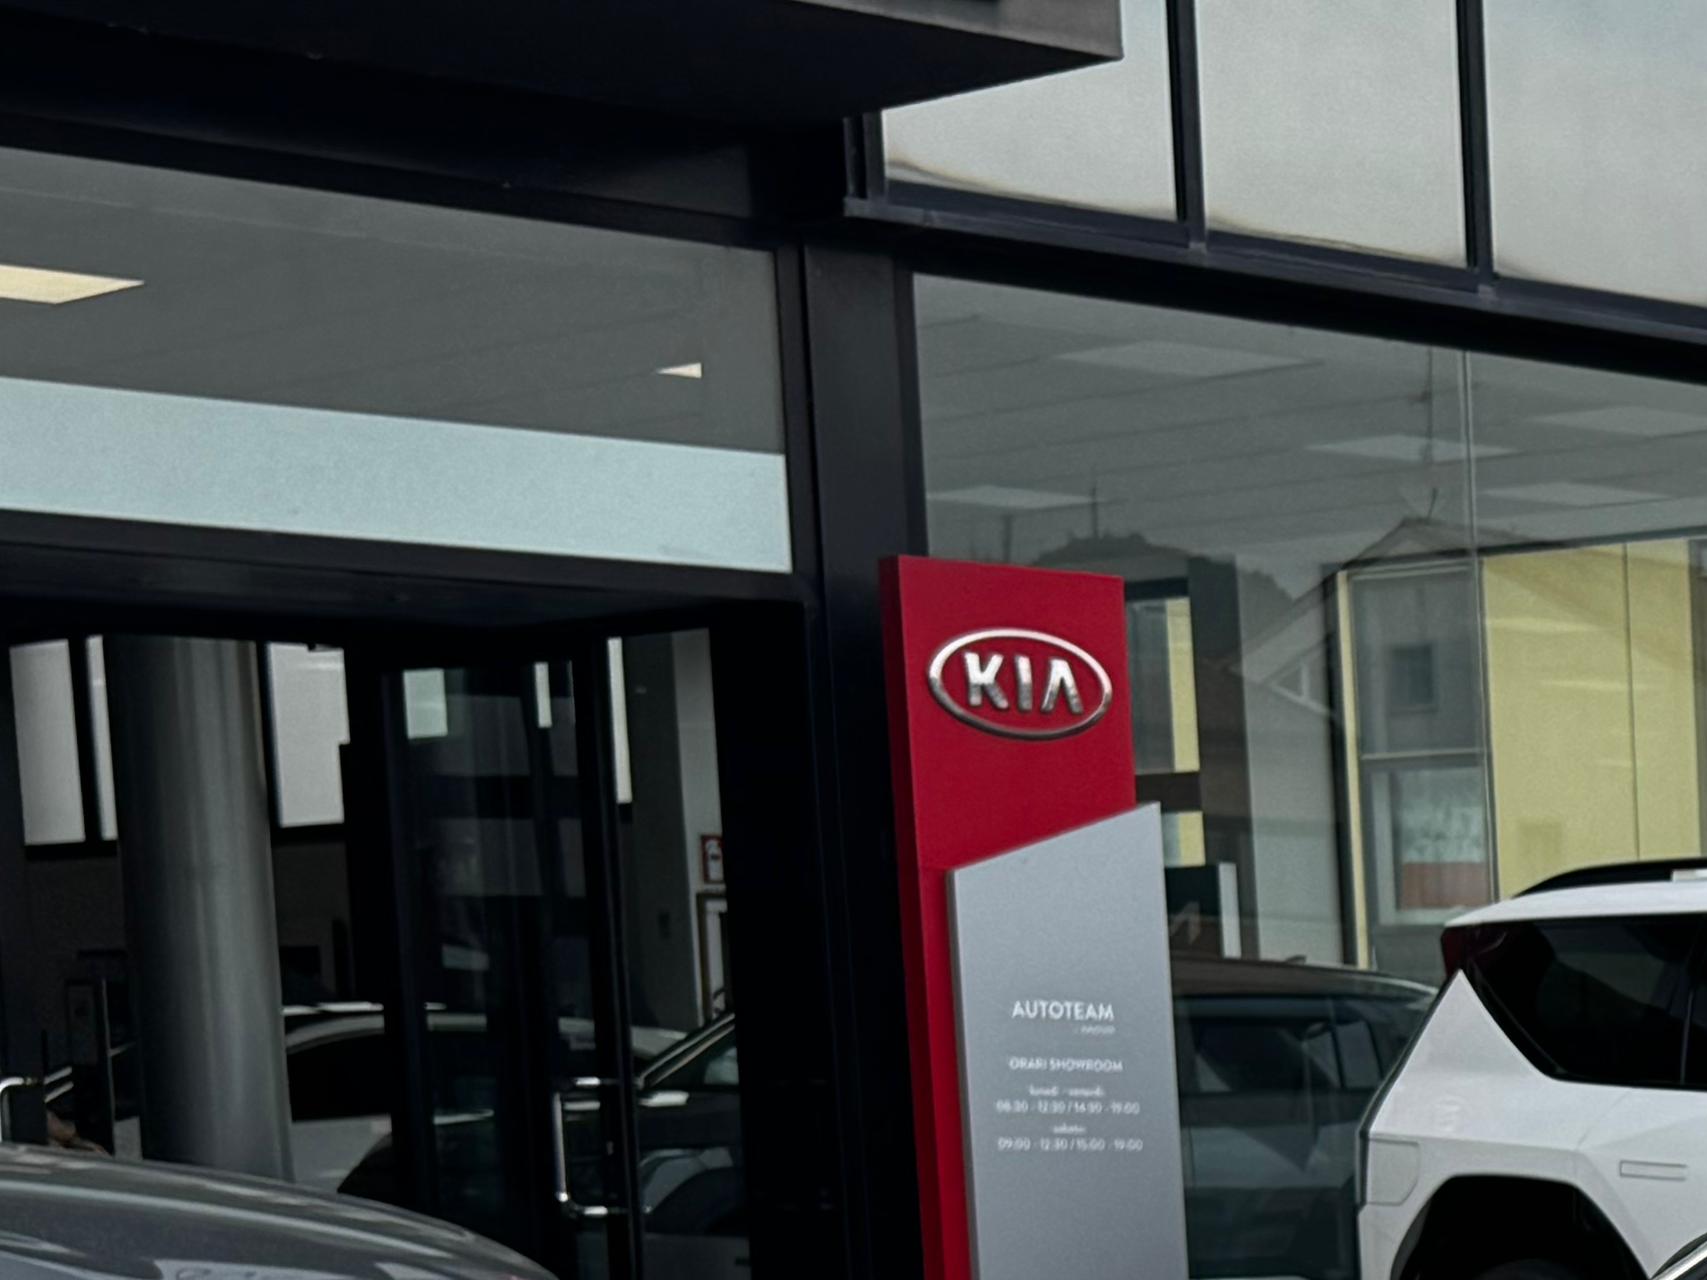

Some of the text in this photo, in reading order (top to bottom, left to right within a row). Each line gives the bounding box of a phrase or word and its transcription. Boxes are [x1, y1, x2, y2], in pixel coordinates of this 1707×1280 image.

[963, 651, 1084, 715] KIA
[1011, 999, 1115, 1022] AUTOTEAM
[1049, 1058, 1123, 1072] SHOWROOM
